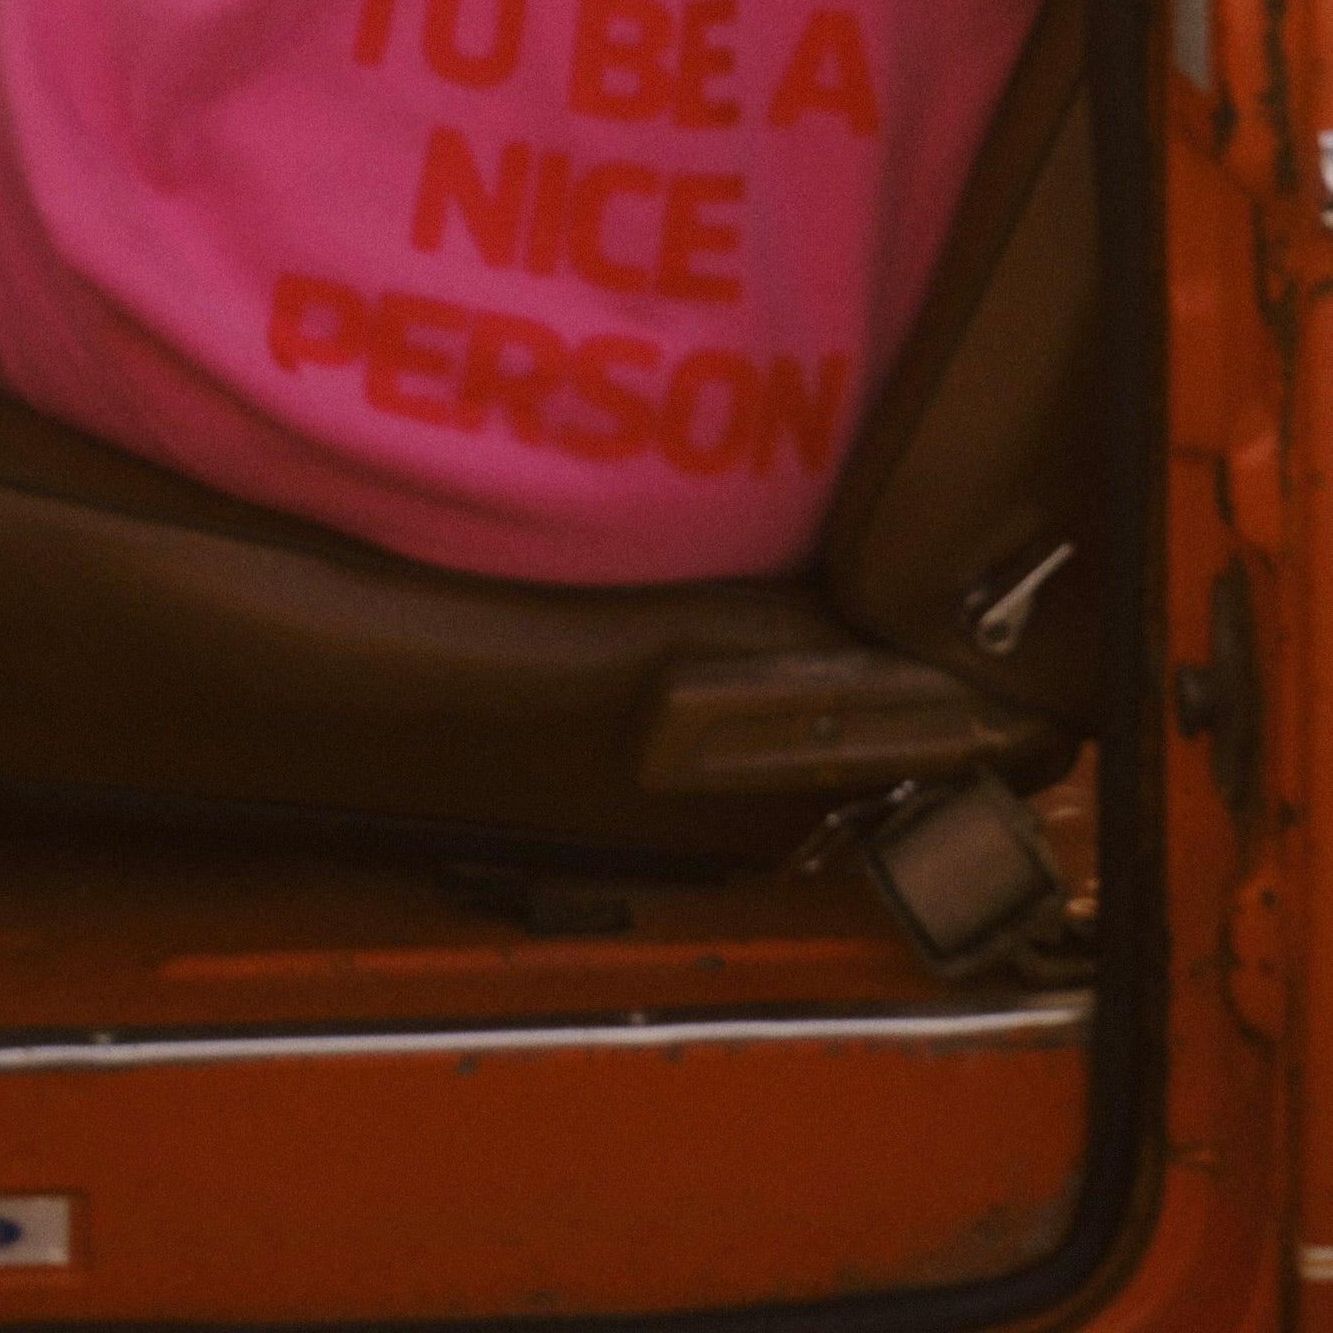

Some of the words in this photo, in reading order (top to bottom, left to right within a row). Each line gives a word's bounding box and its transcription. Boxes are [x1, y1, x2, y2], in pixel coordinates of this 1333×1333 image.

[767, 9, 878, 135] A
[411, 128, 746, 303] NICE
[268, 272, 849, 479] PERSON
